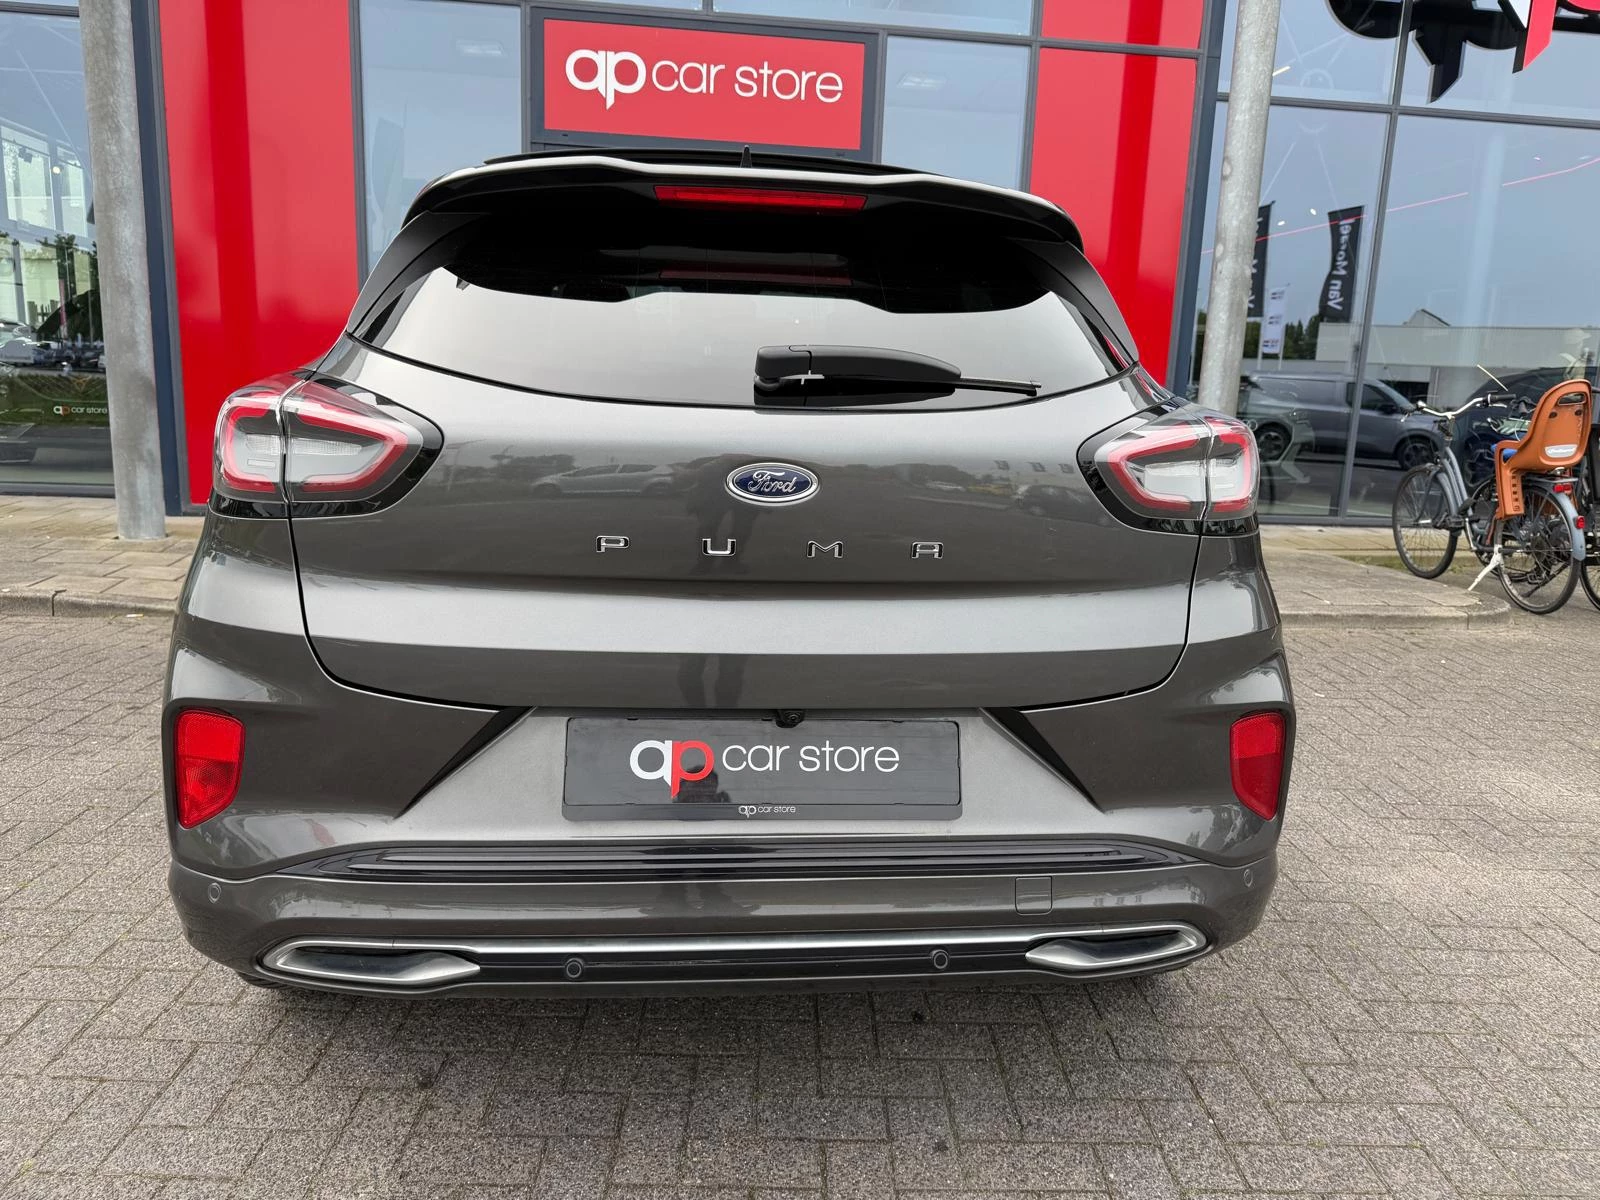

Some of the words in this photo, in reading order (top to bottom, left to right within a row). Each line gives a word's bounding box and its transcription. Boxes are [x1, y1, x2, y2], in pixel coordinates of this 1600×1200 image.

[652, 60, 725, 94] car
[735, 61, 843, 103] store
[747, 470, 797, 493] Ford
[722, 745, 790, 771] car
[799, 740, 900, 772] store
